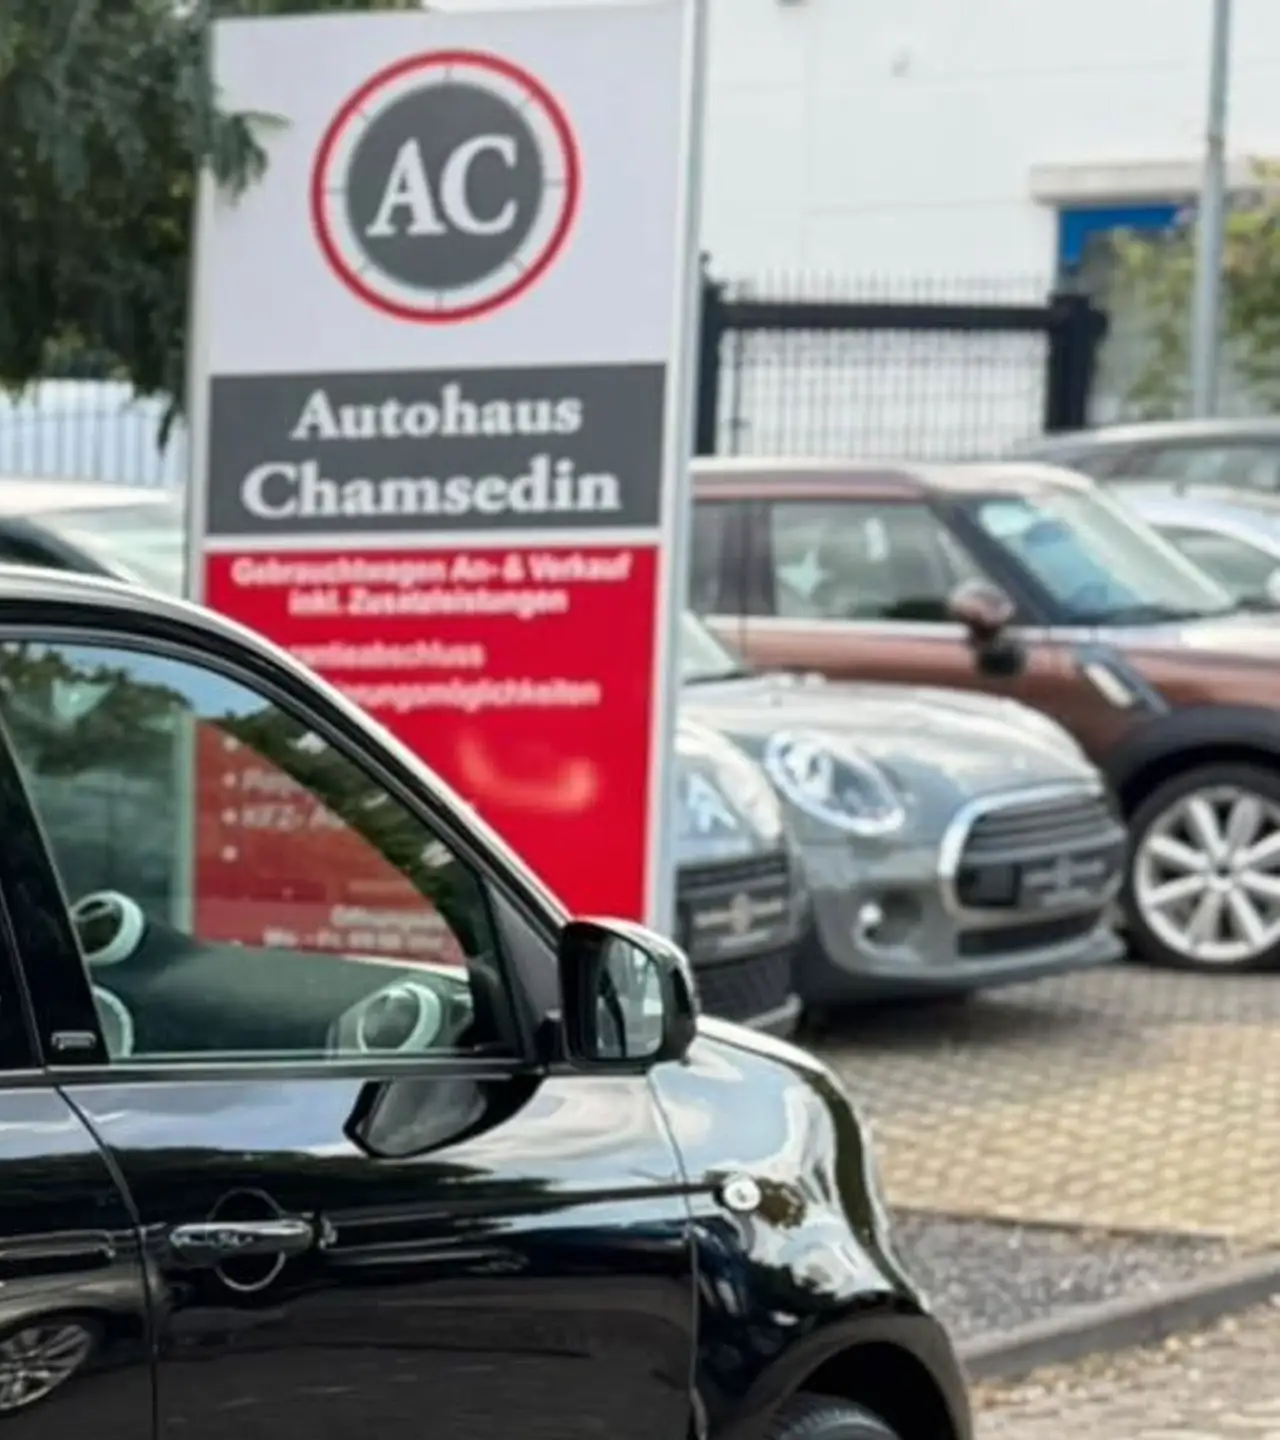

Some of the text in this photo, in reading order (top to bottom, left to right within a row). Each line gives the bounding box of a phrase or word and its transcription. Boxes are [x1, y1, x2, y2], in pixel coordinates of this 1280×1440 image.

[366, 134, 518, 236] AC
[290, 383, 583, 440] Autohaus
[241, 454, 622, 519] Chamsedin
[528, 551, 633, 582] Verkauf
